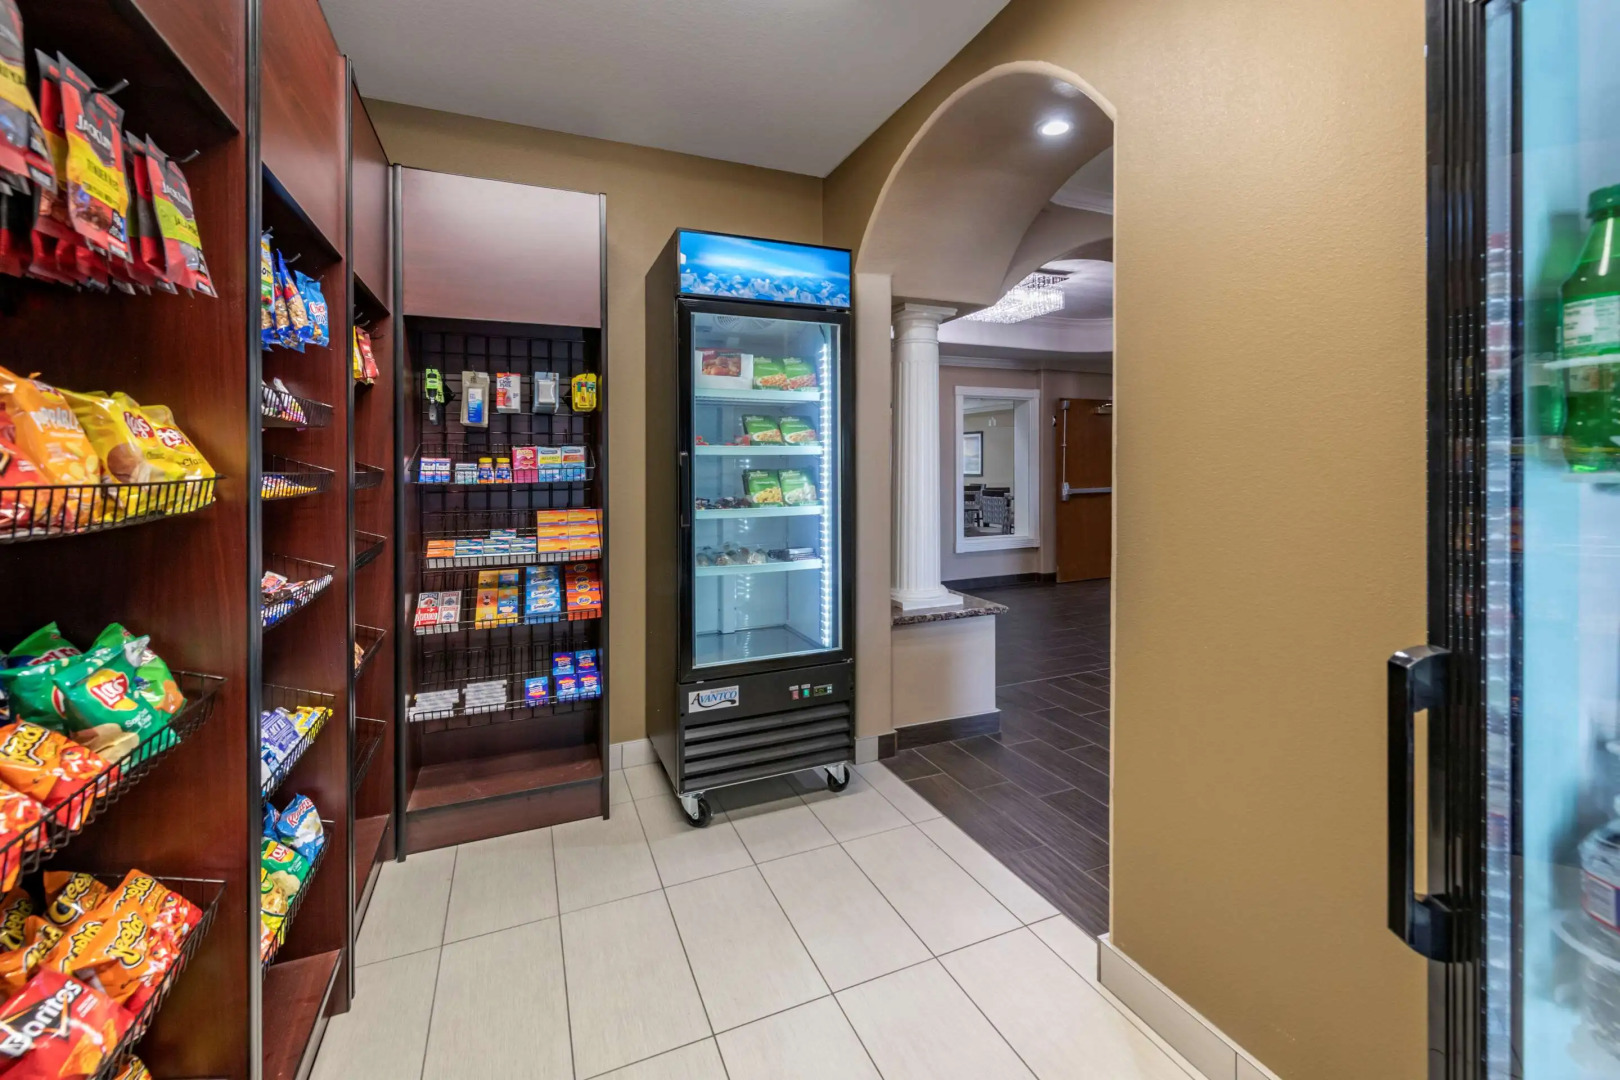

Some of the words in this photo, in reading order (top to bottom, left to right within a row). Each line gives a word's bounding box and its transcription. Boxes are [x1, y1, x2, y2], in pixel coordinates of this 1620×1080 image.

[90, 677, 126, 707] Lay's
[690, 690, 738, 708] AVANTCO
[0, 980, 82, 1056] Doritos
